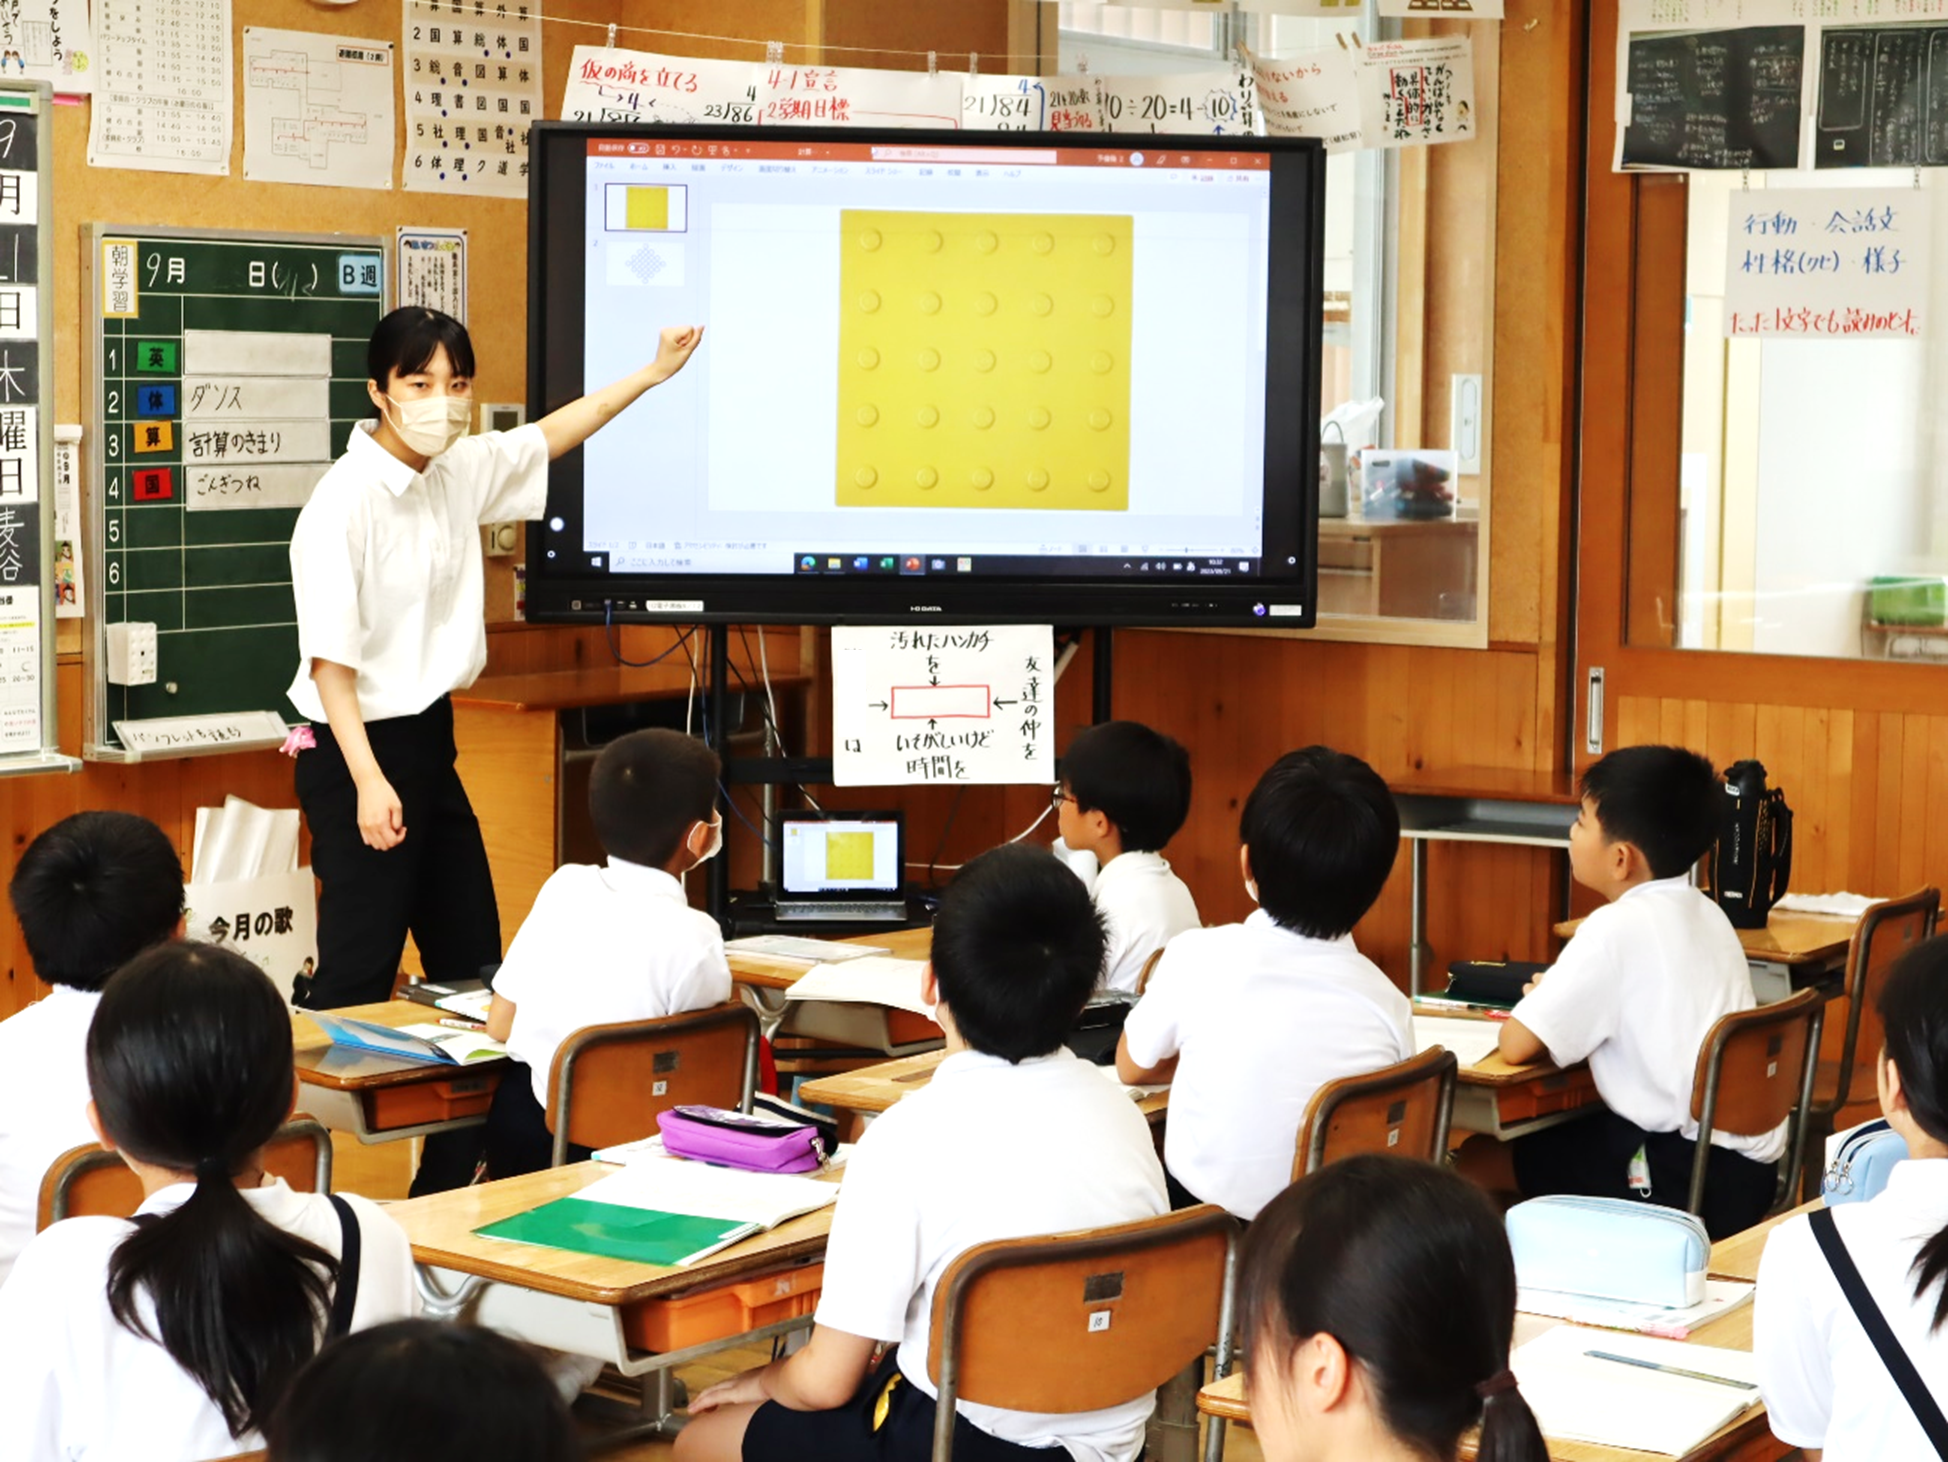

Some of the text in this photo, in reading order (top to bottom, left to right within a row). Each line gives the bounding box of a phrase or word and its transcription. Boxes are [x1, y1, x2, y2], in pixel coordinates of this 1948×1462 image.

[413, 28, 421, 40] 2
[430, 29, 440, 43] 国
[414, 59, 421, 72] 3
[415, 91, 422, 104] 4
[417, 124, 424, 137] 5
[415, 156, 422, 169] 6
[112, 244, 128, 313] 朝学習
[109, 347, 164, 371] 1 英
[108, 382, 243, 413] 2 体 ダンス
[109, 426, 281, 458] 3 算 計算のきまり
[108, 477, 119, 499] 4
[196, 473, 262, 496] ごんぎつね
[109, 520, 119, 542] 5
[109, 562, 119, 584] 6
[630, 558, 692, 567] ここに入力して検索
[890, 630, 994, 652] 汚れたハンカチ
[926, 655, 941, 674] を
[1020, 656, 1043, 761] 友達の仲を
[845, 738, 862, 753] は
[896, 730, 995, 752] いそがしいけど
[906, 755, 970, 779] 時間を
[208, 906, 294, 943] 今月の歌
